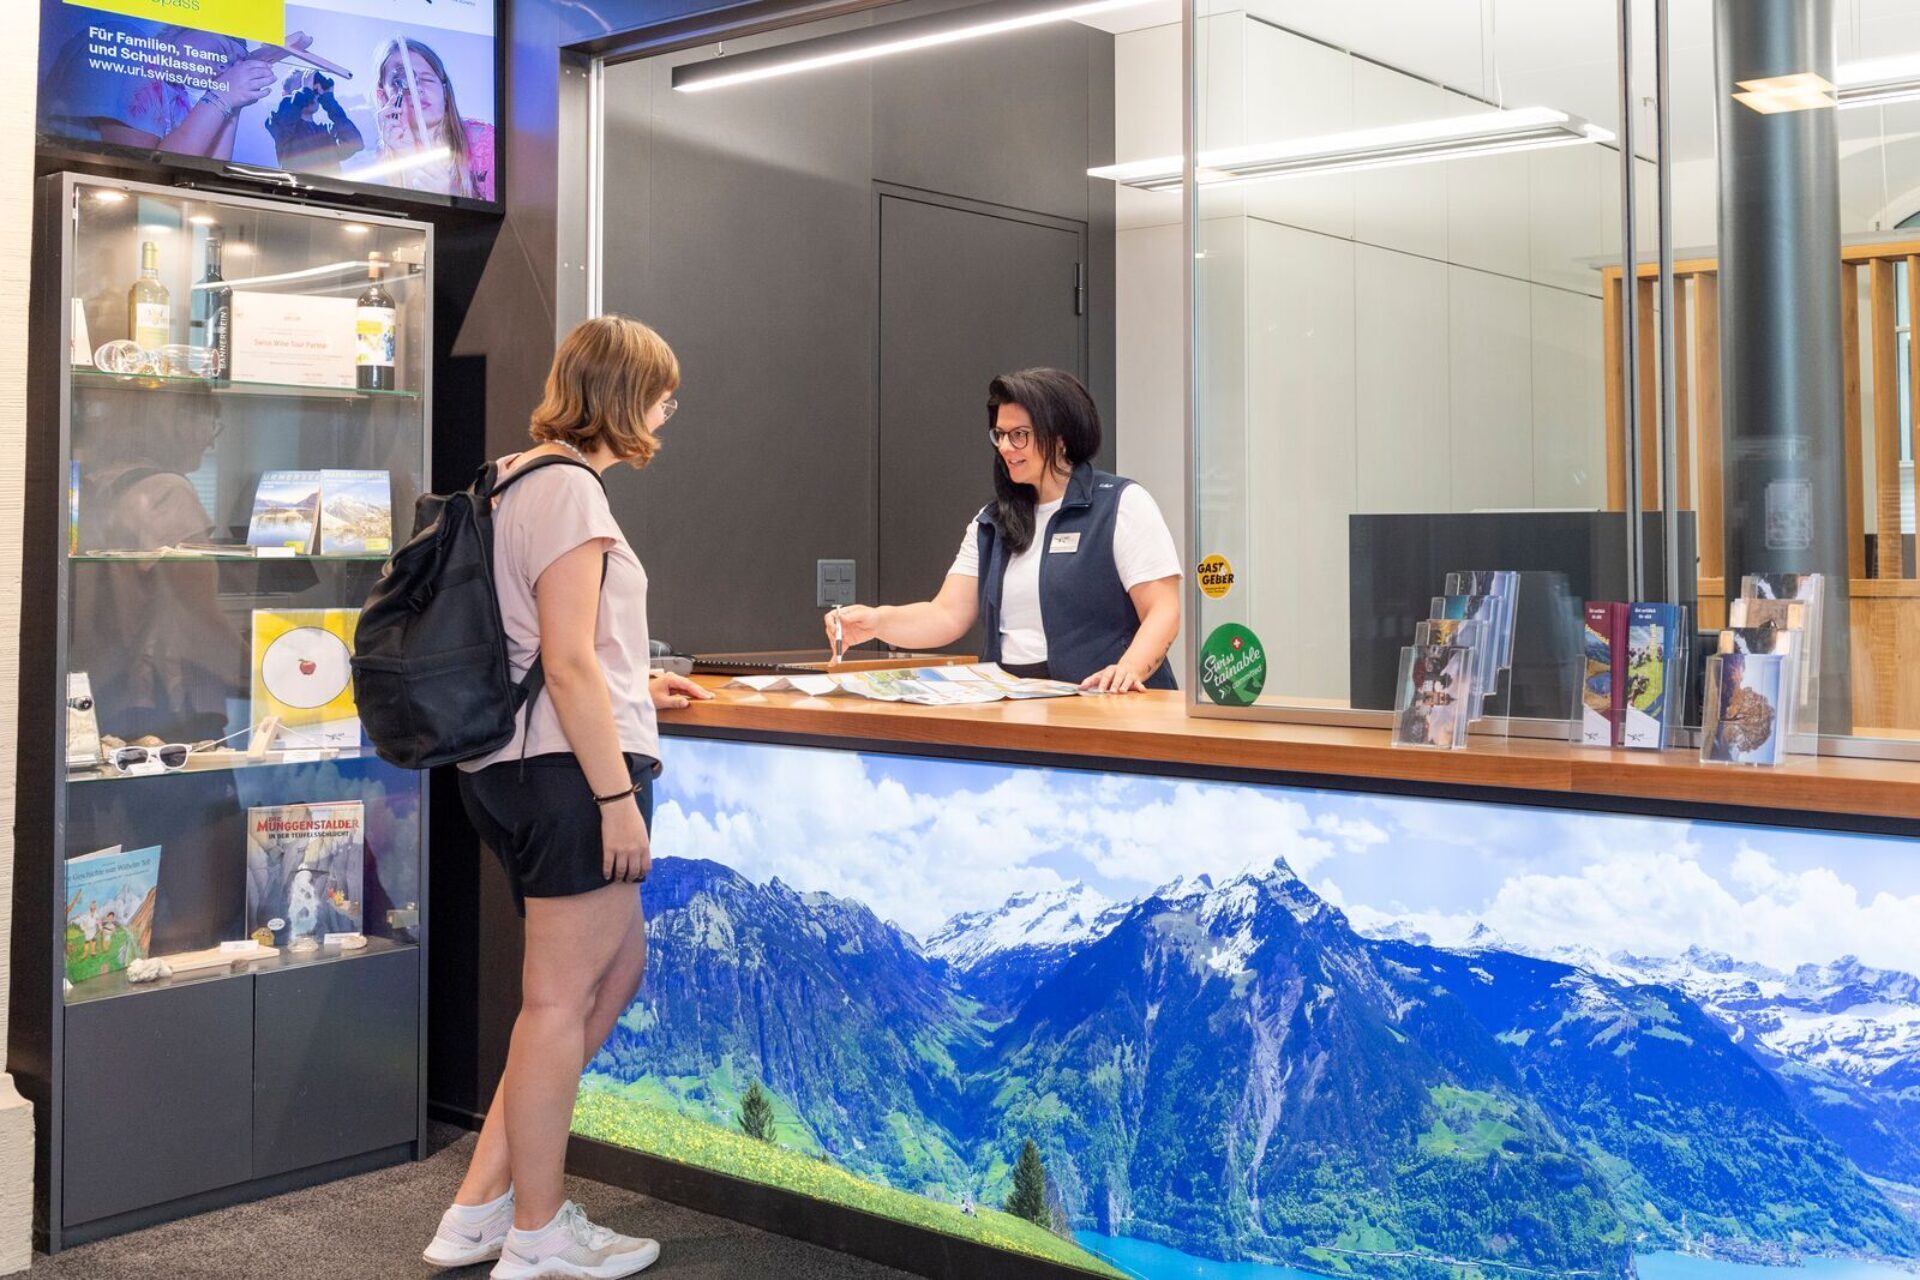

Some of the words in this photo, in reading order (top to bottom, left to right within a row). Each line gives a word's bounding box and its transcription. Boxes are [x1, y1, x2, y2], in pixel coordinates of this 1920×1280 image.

[89, 26, 114, 42] Für
[117, 31, 180, 56] Familien,
[183, 44, 228, 63] Teams
[89, 43, 118, 57] und
[120, 47, 217, 76] Schulklassen.
[89, 58, 230, 92] www.uri.swiss/raetsel
[220, 311, 229, 369] BANNERWEIN
[1197, 562, 1224, 574] GAST
[1202, 573, 1234, 585] GEBER
[1203, 653, 1234, 683] Swiss
[1214, 646, 1260, 687] tainable
